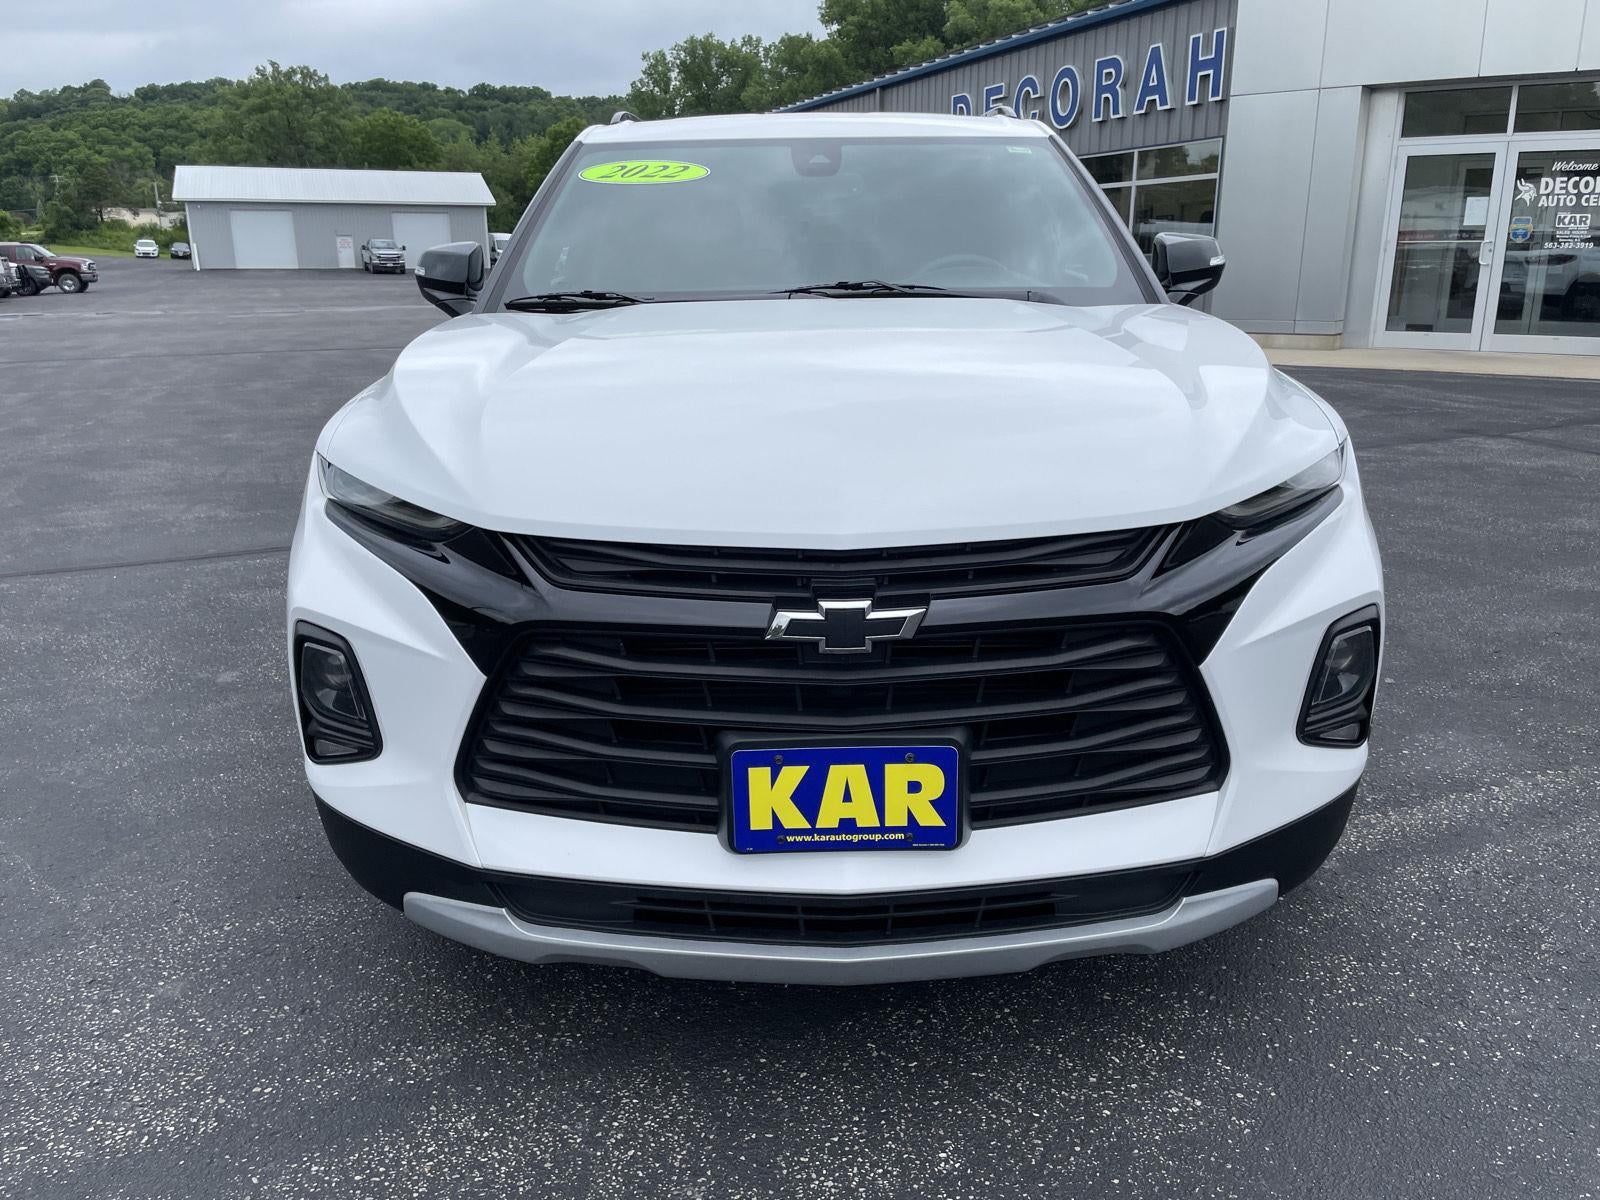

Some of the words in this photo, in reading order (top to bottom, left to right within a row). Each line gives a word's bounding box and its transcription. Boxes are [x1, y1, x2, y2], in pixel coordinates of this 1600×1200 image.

[597, 164, 690, 179] 2022
[1552, 161, 1599, 171] Welcome
[1538, 194, 1576, 207] AUTO
[1581, 194, 1600, 207] CE
[1557, 215, 1590, 226] KAR
[748, 763, 947, 830] KAR
[786, 832, 905, 842] www.karautogroup.com
